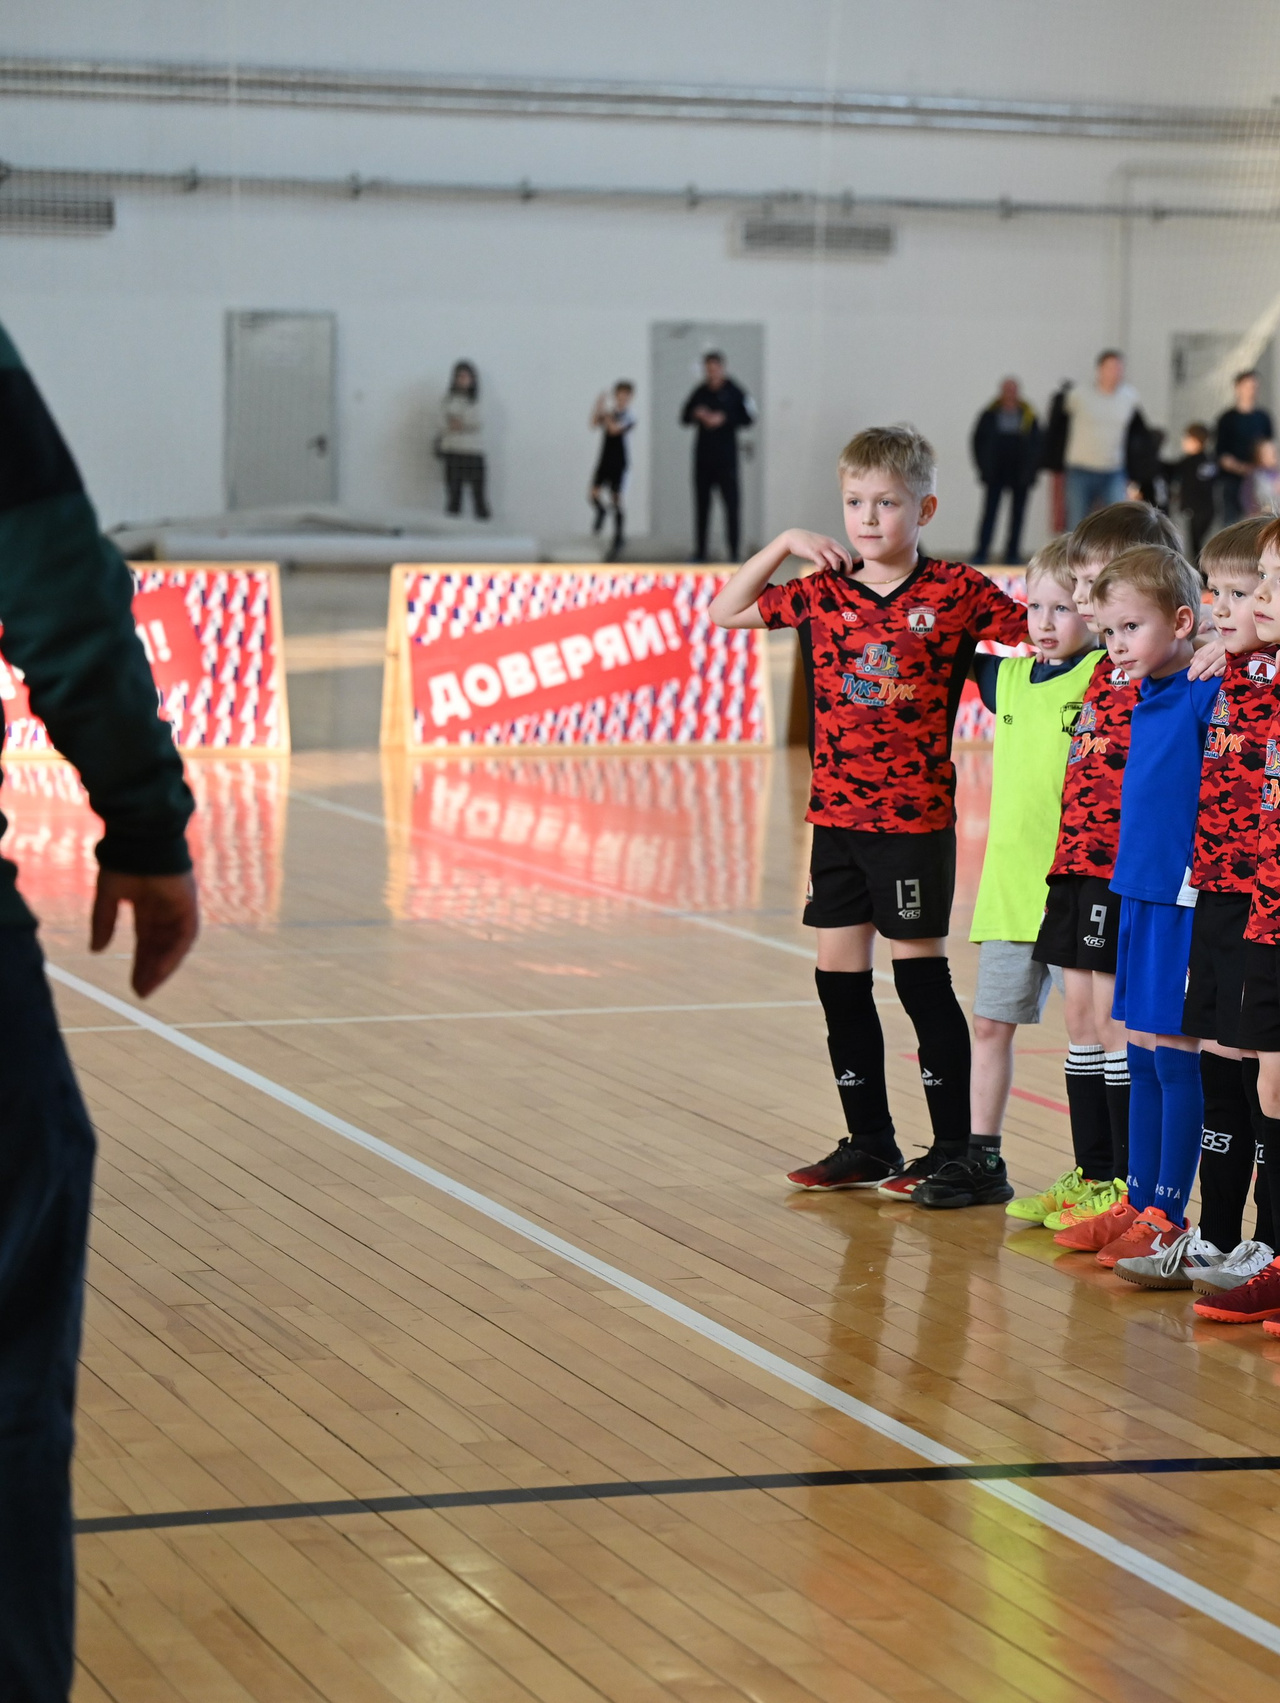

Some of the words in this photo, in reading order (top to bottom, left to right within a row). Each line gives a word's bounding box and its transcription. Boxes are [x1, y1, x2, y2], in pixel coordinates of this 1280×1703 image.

[428, 607, 681, 726] ДОВЕРЯЙ!
[842, 673, 916, 704] Тук-Тук
[896, 879, 920, 908] 13
[1090, 904, 1107, 935] 9
